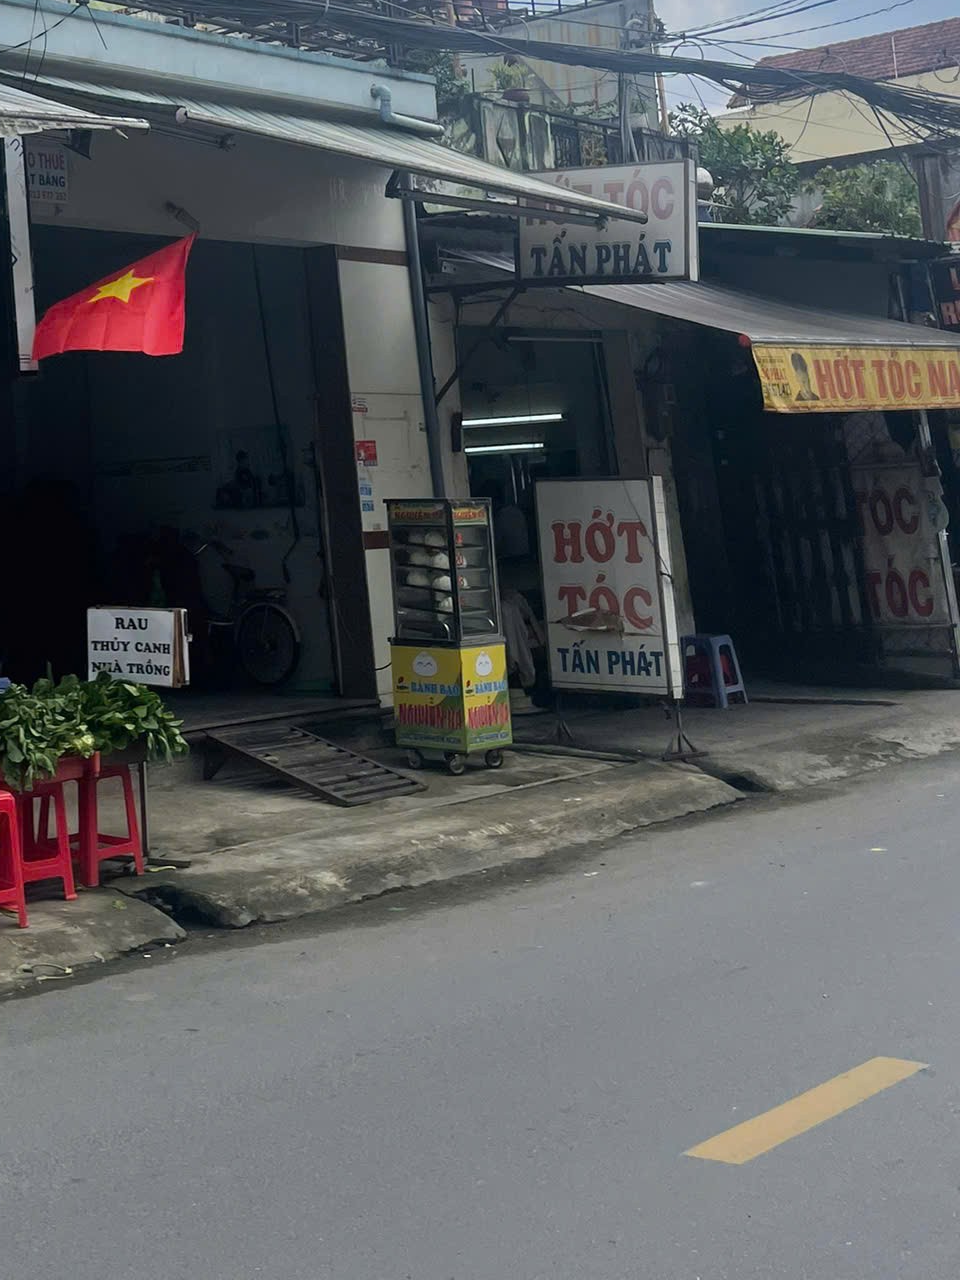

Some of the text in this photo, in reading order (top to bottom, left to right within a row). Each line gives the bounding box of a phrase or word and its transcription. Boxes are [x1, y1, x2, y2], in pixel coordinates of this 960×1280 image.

[530, 229, 672, 276] TẤN PHÁT
[812, 350, 865, 401] HỚT
[871, 350, 922, 400] TÓC
[551, 508, 647, 564] HỚT
[114, 617, 148, 630] RAU
[558, 573, 654, 630] TÓC
[91, 637, 171, 655] THỦY CANH
[556, 639, 664, 677] TẤN PHÁT
